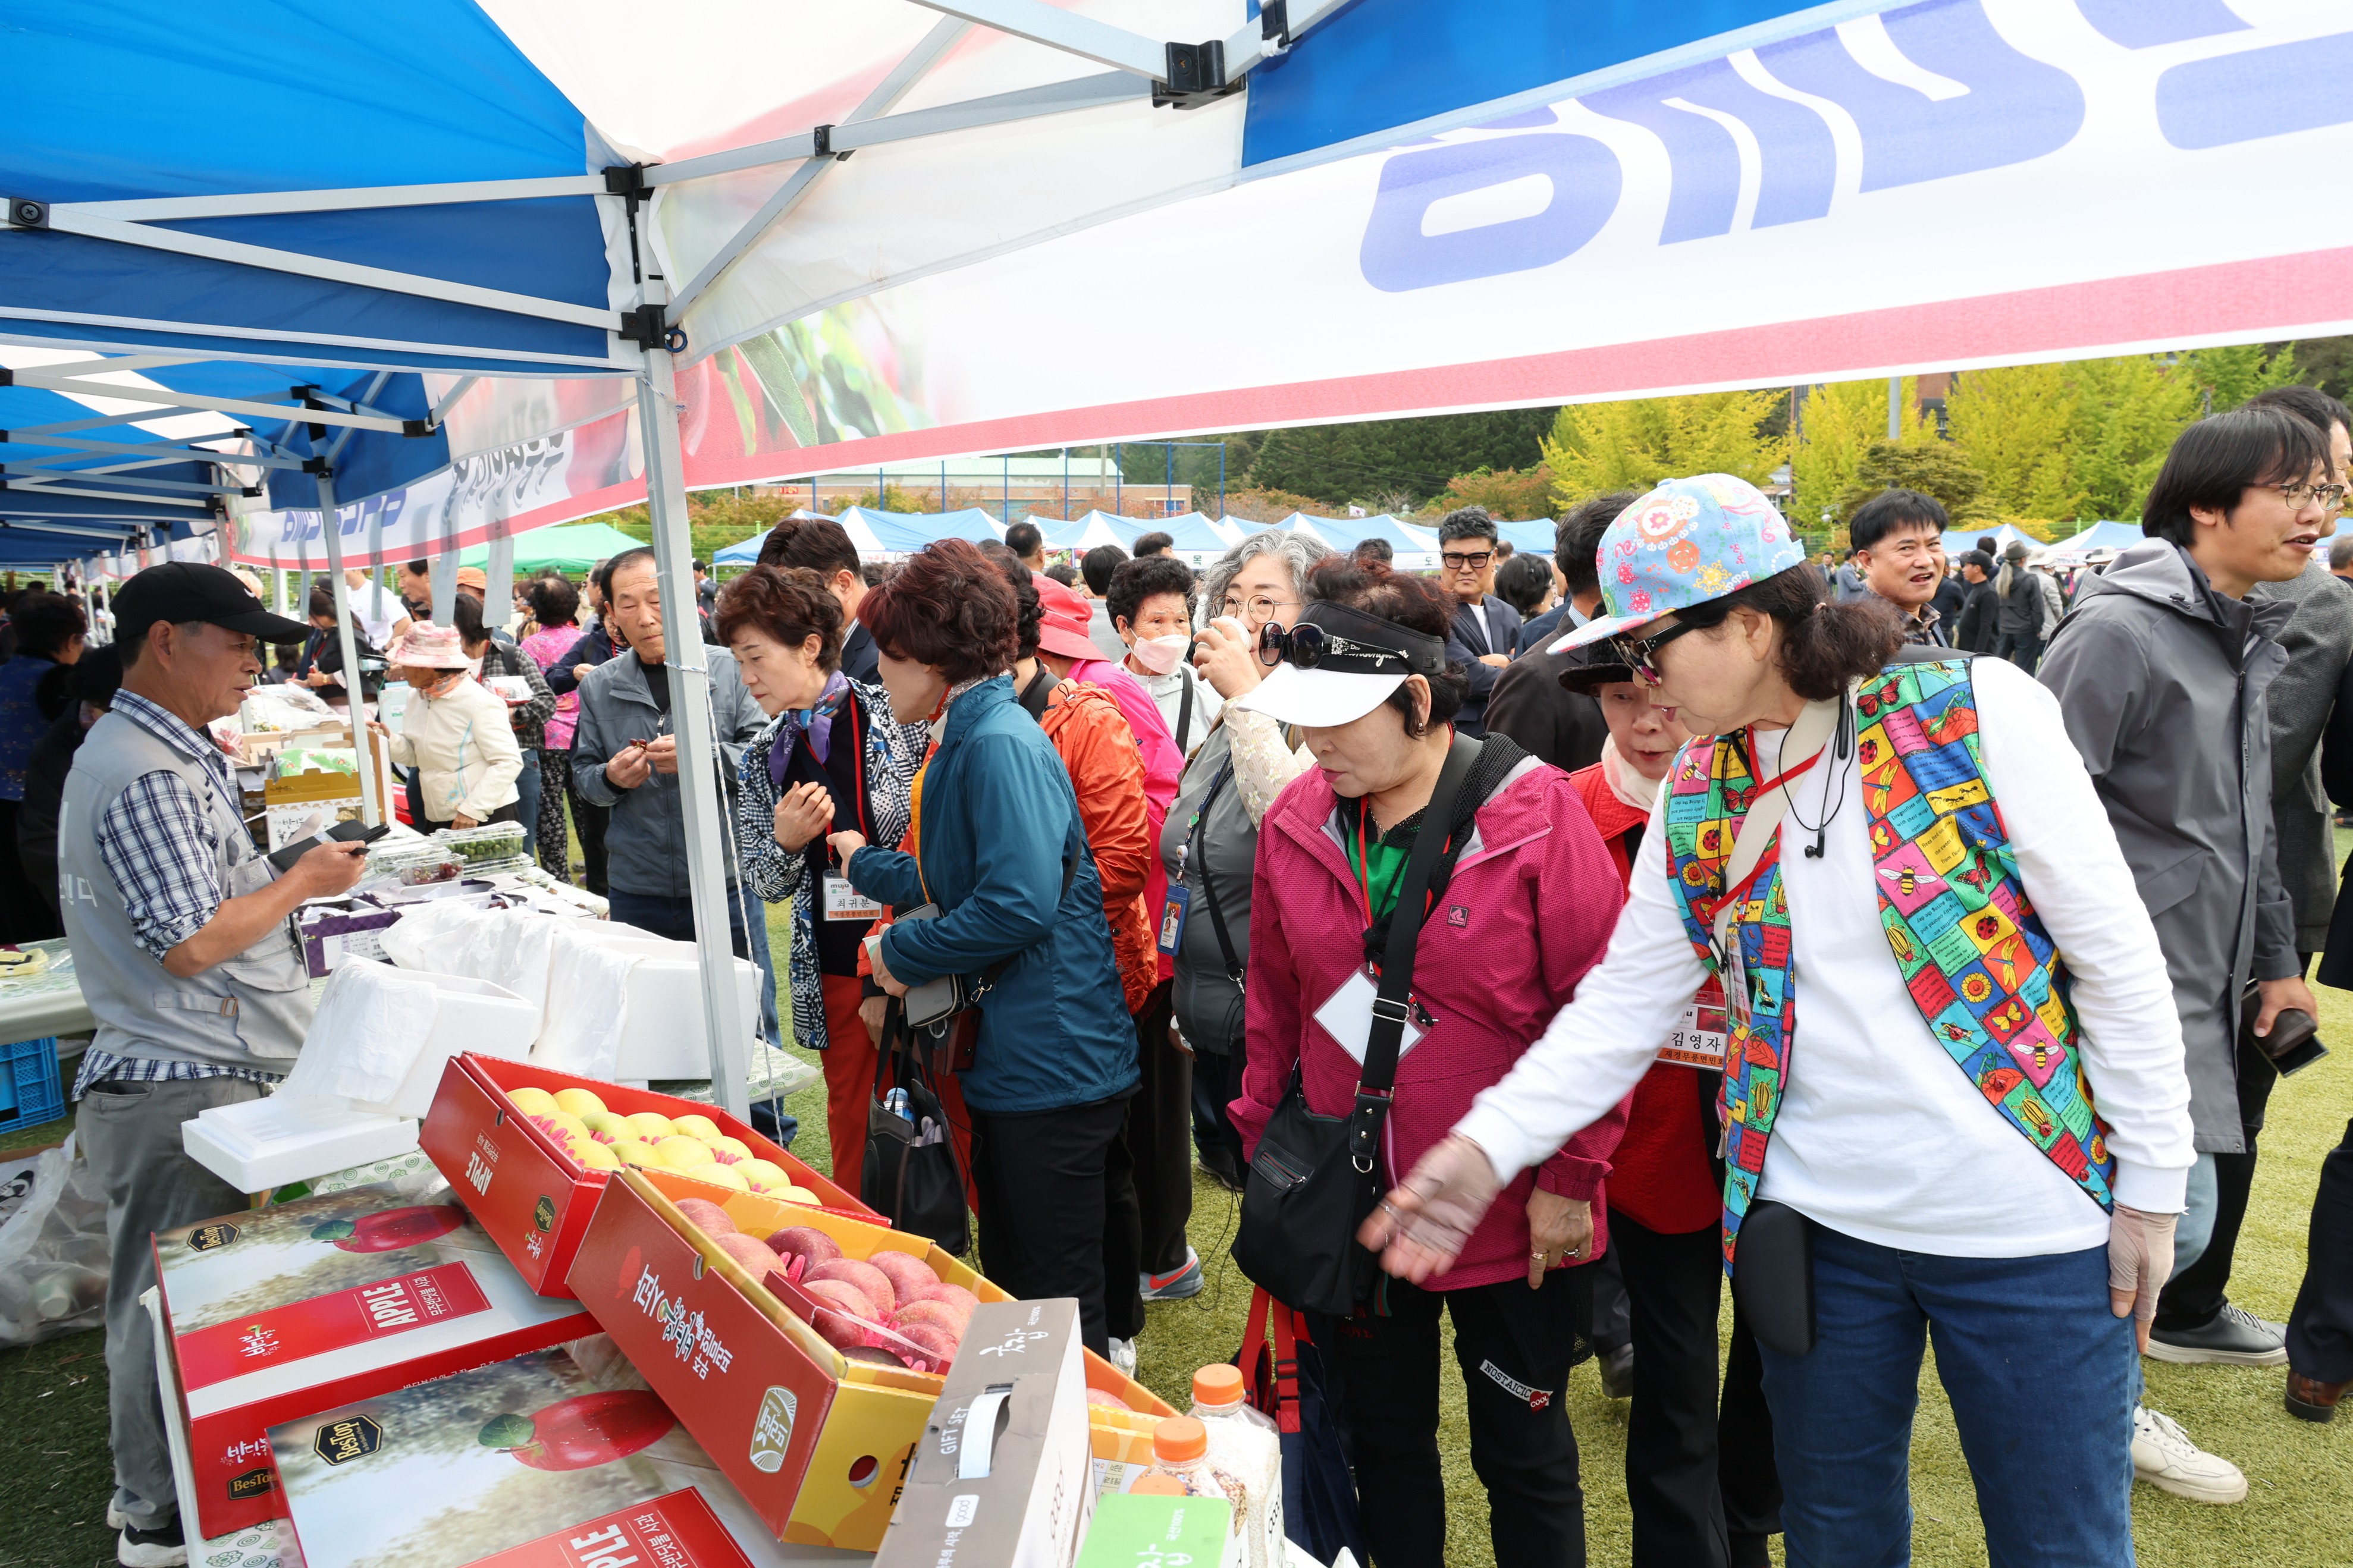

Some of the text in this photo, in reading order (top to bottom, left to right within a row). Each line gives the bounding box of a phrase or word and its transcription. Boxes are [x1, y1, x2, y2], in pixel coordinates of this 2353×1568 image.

[1193, 555, 1201, 565] 목
[1425, 557, 1432, 565] 도
[1891, 802, 1916, 820] Dragonflies
[1896, 819, 1907, 827] with
[1906, 814, 1918, 823] their
[1911, 823, 1923, 833] open.
[1921, 839, 1933, 849] Bees
[1930, 901, 1945, 912] during
[1916, 915, 1925, 923] day
[1919, 901, 1959, 934] brightly colored and
[1940, 912, 1959, 931] Butterflies
[464, 1151, 493, 1196] APPLE
[534, 1201, 553, 1228] BesTop
[202, 1226, 223, 1250] BesTop
[412, 1275, 447, 1316] 무주반딧불 사과
[632, 1262, 664, 1317] 사과
[362, 1281, 419, 1328] APPLE
[698, 1326, 733, 1374] 프리미엄
[691, 1352, 708, 1381] 무주
[1530, 1395, 1549, 1408] COOL
[335, 1420, 360, 1462] BesTop
[940, 1429, 959, 1455] GIFT
[233, 1473, 277, 1492] BesTo
[633, 1513, 661, 1534] 사과
